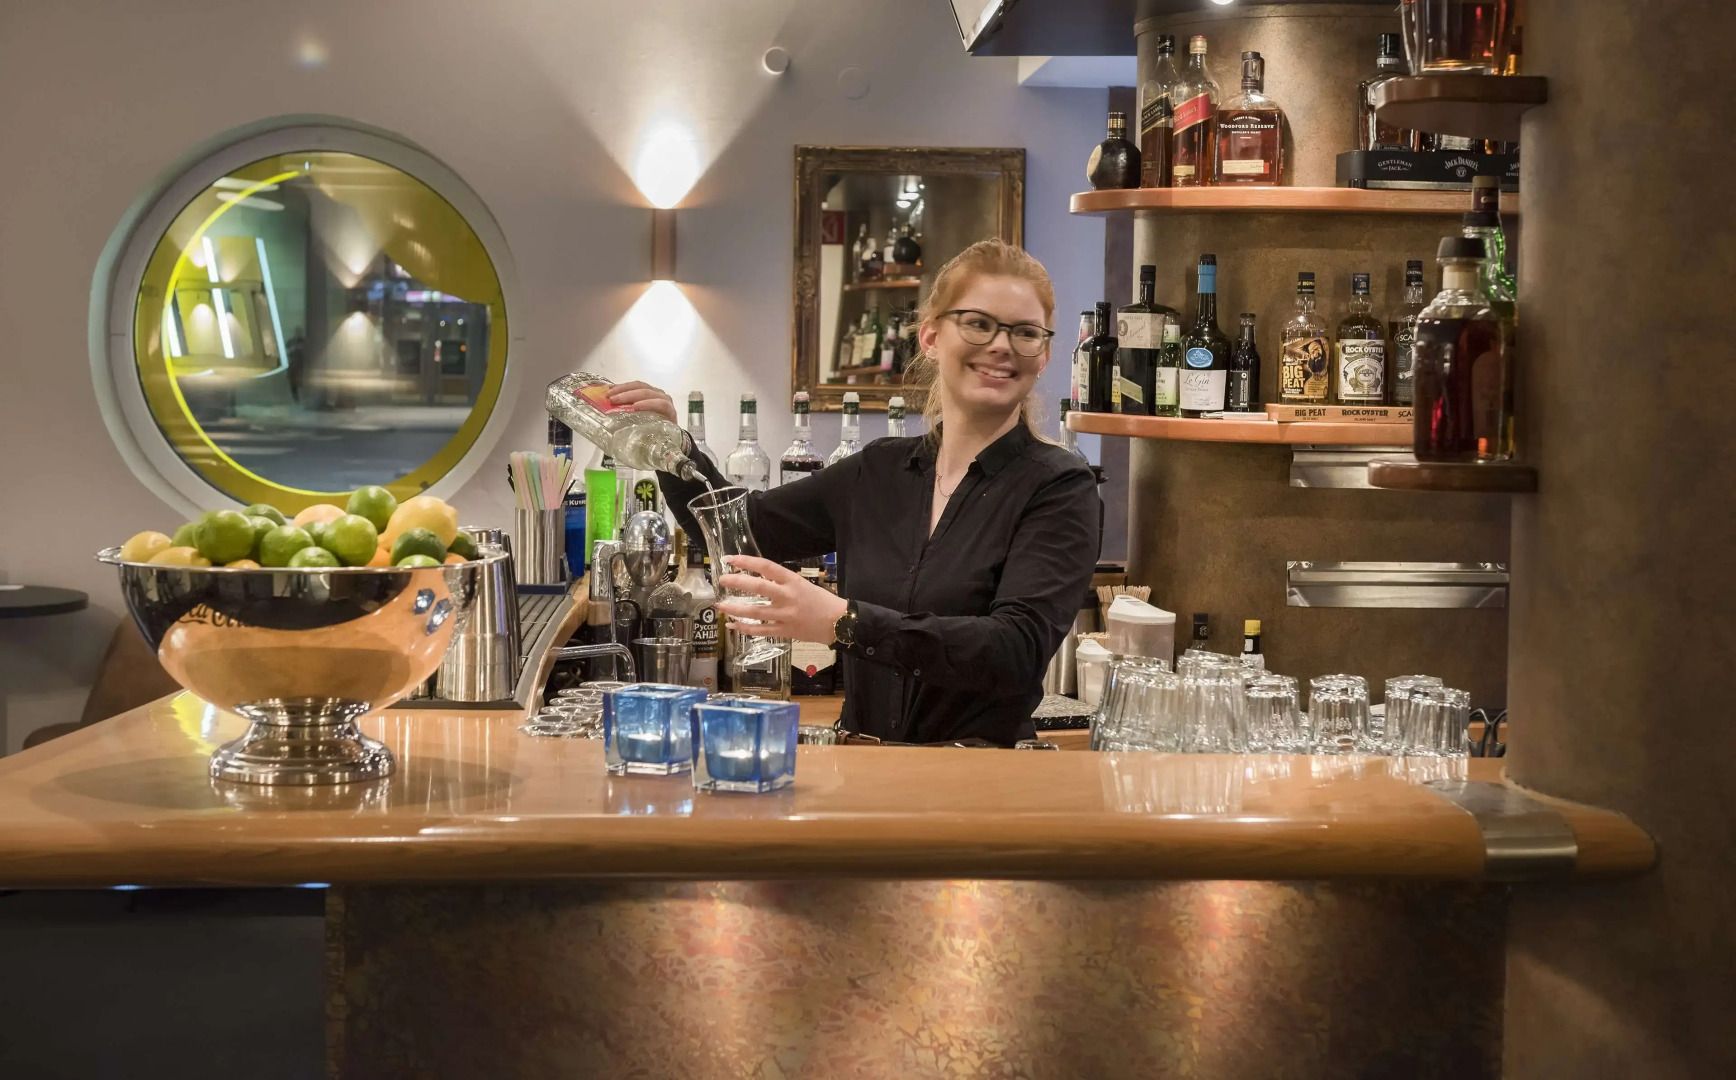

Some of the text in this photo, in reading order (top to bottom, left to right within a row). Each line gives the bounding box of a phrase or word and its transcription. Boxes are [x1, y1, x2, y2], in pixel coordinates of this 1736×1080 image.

[1184, 106, 1197, 117] Label
[1377, 159, 1413, 168] GENTLEMAN
[1444, 156, 1479, 172] JACK DANIEL'S
[1345, 346, 1363, 354] ROCK
[1282, 365, 1304, 379] BIG
[1184, 372, 1210, 387] Le Gin
[1282, 378, 1306, 388] PEAT
[1295, 408, 1326, 417] BIG PEAT
[1361, 409, 1389, 417] OYSTER
